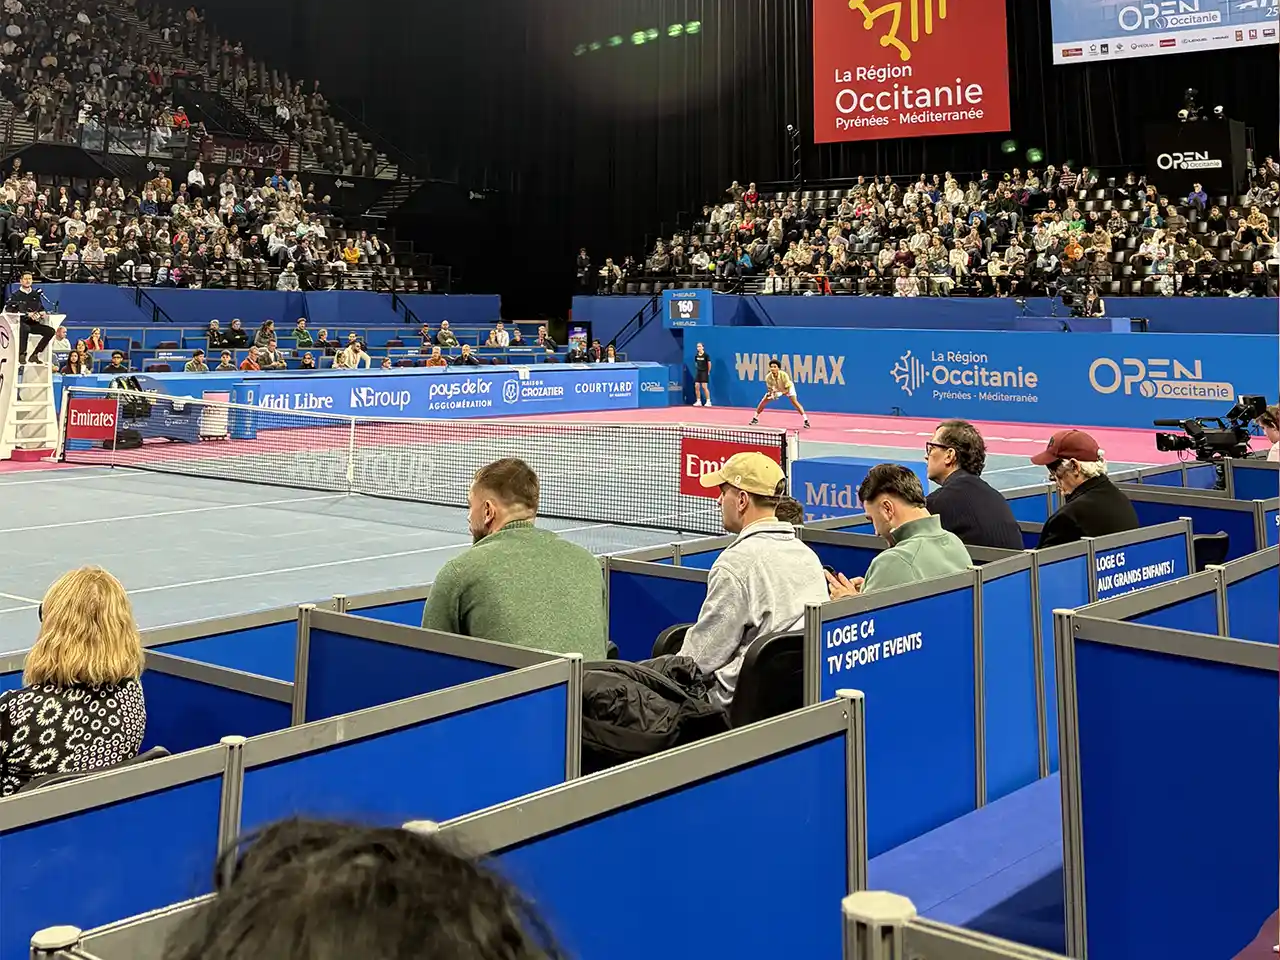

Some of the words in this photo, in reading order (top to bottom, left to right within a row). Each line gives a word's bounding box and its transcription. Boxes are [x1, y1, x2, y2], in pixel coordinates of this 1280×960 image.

[1170, 12, 1218, 26] Occitanie
[835, 68, 852, 83] La
[856, 65, 912, 83] Région
[835, 78, 983, 114] Occitanie
[835, 114, 889, 130] Pyrénées
[899, 107, 984, 124] Méditerranée
[1157, 150, 1209, 170] OPEN
[677, 300, 693, 312] 160
[931, 351, 945, 362] La
[947, 350, 988, 365] Région
[932, 365, 1038, 388] Occitanie
[1089, 357, 1203, 395] OPEN
[429, 383, 461, 400] pays
[521, 386, 564, 397] CROZATIER
[933, 390, 971, 403] Pyrénées
[979, 391, 1038, 403] Méditerranée
[1160, 383, 1229, 398] Occitanie
[294, 392, 333, 410] Libre
[429, 399, 493, 410] AGGLOMÉRATION
[70, 409, 114, 428] Emirates
[1096, 554, 1116, 572] LOGE
[1116, 552, 1125, 567] C5
[1097, 575, 1114, 592] AUX
[1113, 567, 1142, 588] GRANDS
[1142, 560, 1171, 580] ENFANTS
[827, 623, 858, 649] LOGE
[860, 618, 875, 639] C4
[827, 653, 843, 675] TV
[845, 642, 881, 670] SPORT
[882, 631, 922, 659] EVENTS
